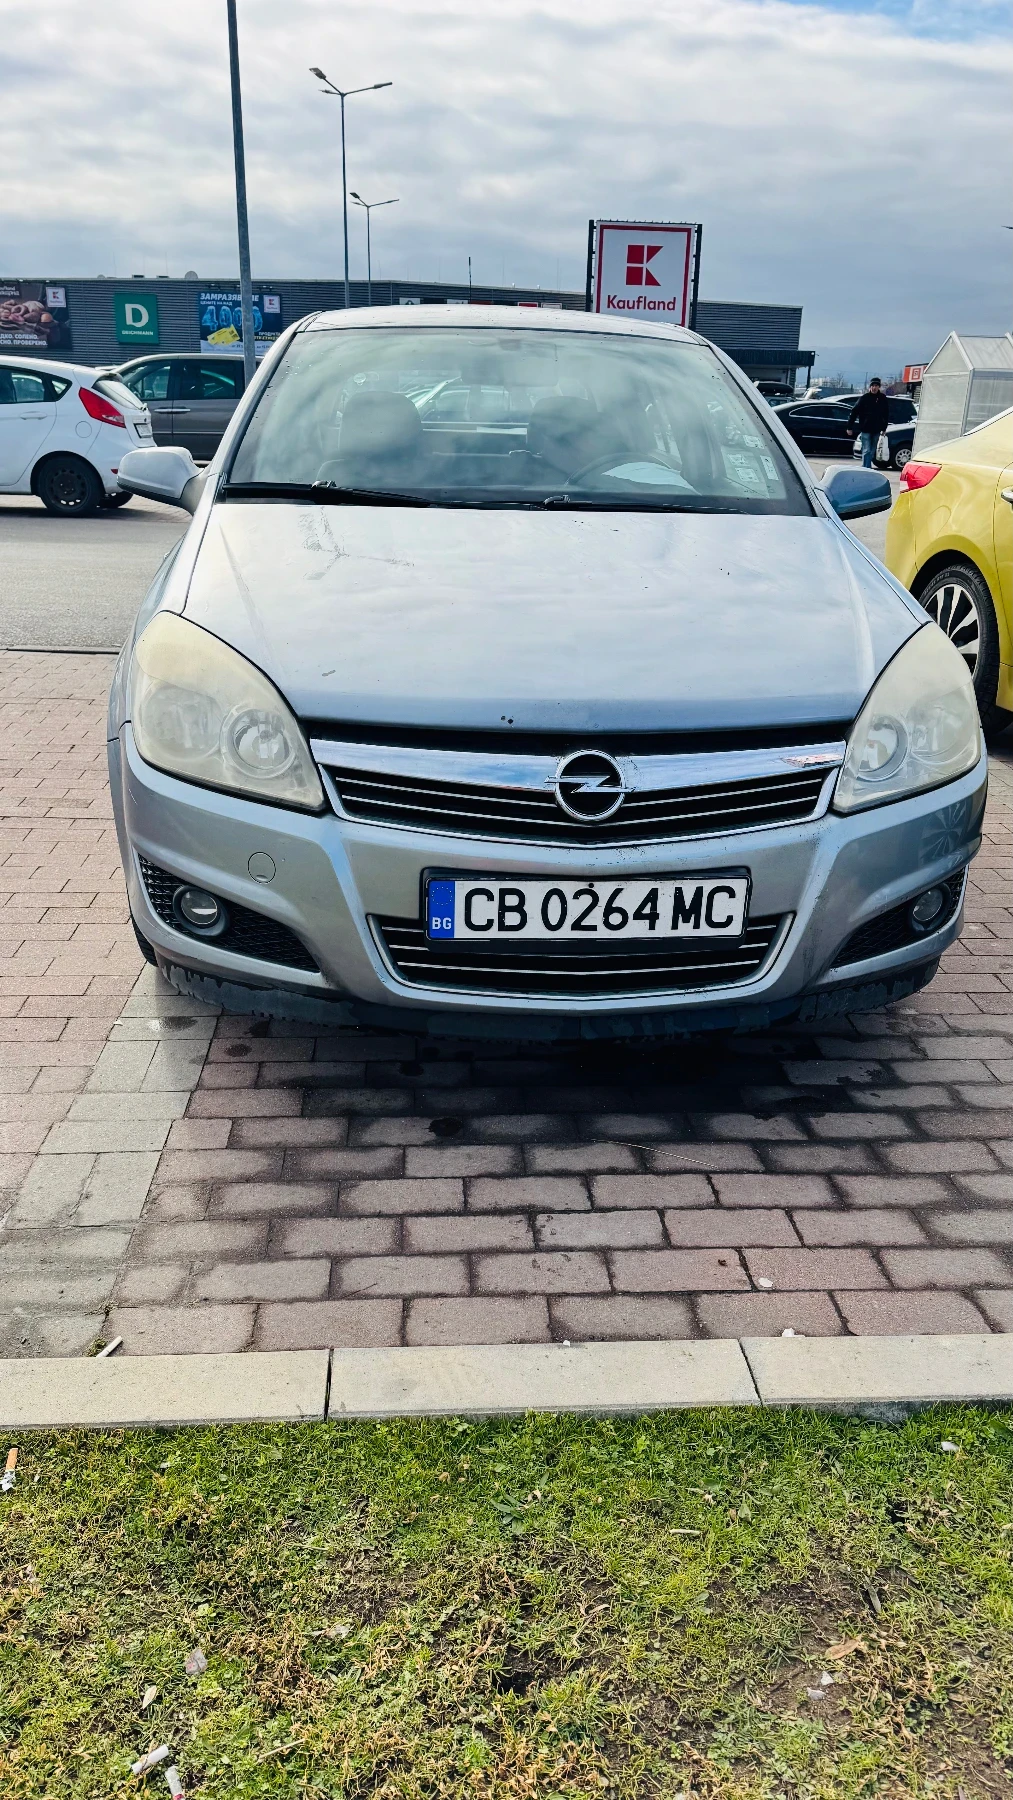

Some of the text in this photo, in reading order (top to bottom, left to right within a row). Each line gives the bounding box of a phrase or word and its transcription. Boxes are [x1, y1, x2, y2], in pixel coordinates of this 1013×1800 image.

[200, 293, 259, 302] ЗАМРАЗЯВЕ
[607, 294, 677, 311] Kaufland
[125, 303, 149, 328] D
[464, 885, 736, 931] CB 0264 MC
[431, 917, 452, 930] BG
